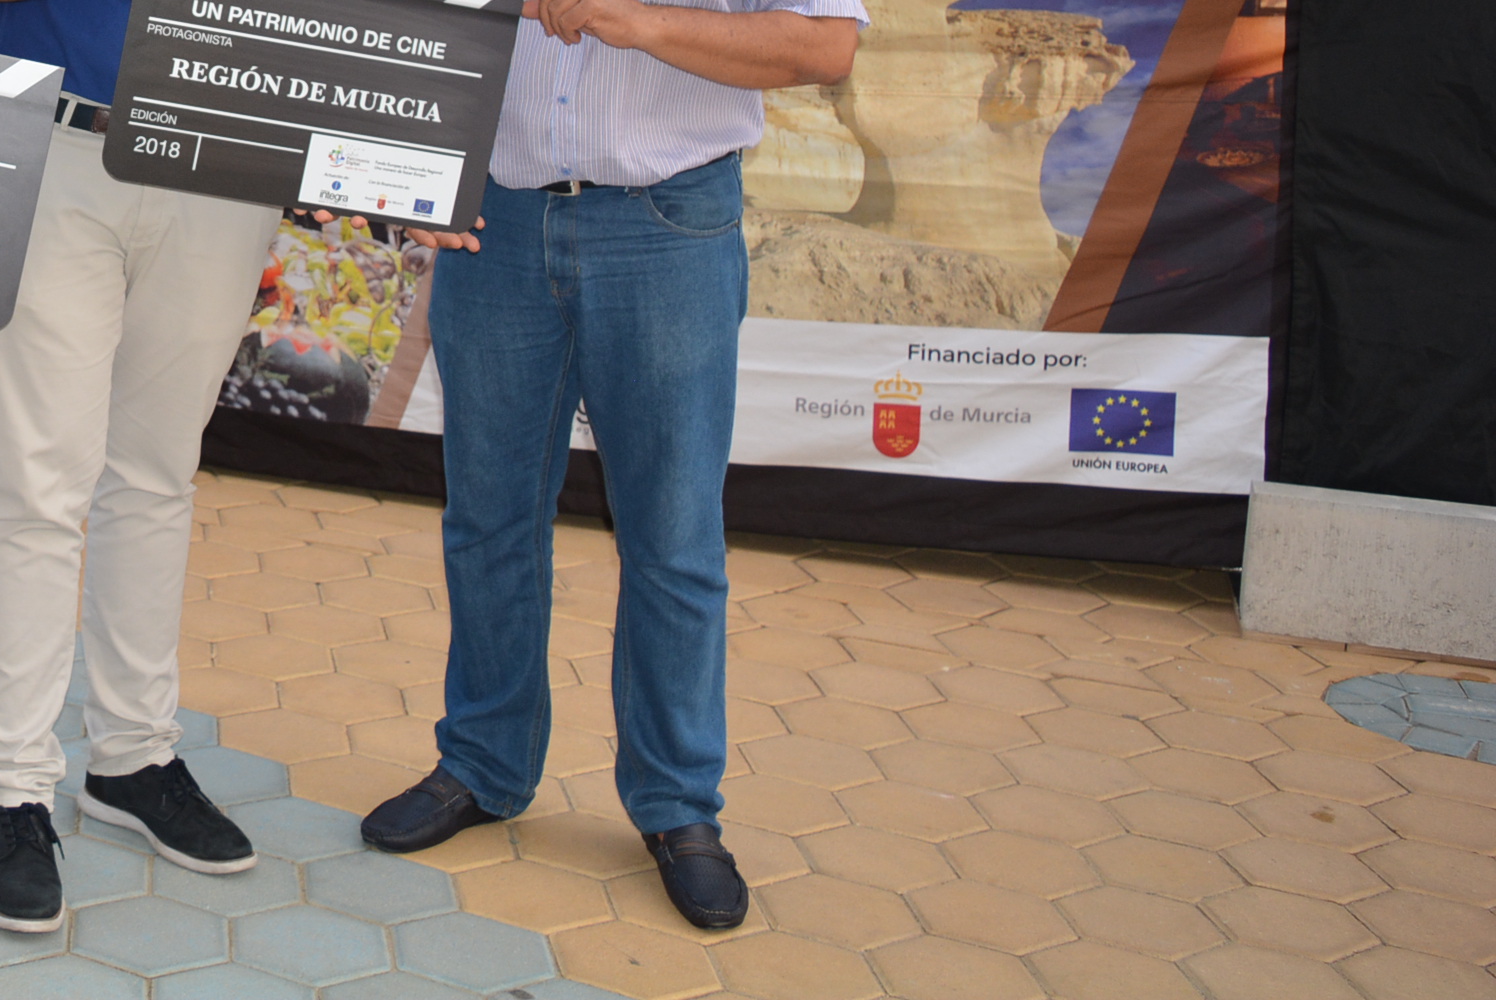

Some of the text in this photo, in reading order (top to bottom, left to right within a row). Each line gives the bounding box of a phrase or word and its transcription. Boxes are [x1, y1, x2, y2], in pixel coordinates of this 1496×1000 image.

[146, 23, 233, 48] PROTAGONISTA
[191, 0, 447, 60] UN PATRIMONIO DE CINE
[169, 57, 443, 123] REGIÓN DE MURCIA
[130, 107, 178, 126] EDICIÓN
[132, 135, 181, 160] 2018
[906, 343, 1088, 371] Financiado por:
[794, 397, 1032, 425] Región de Murcia
[1072, 457, 1168, 474] UNIÓN EUROPEA
